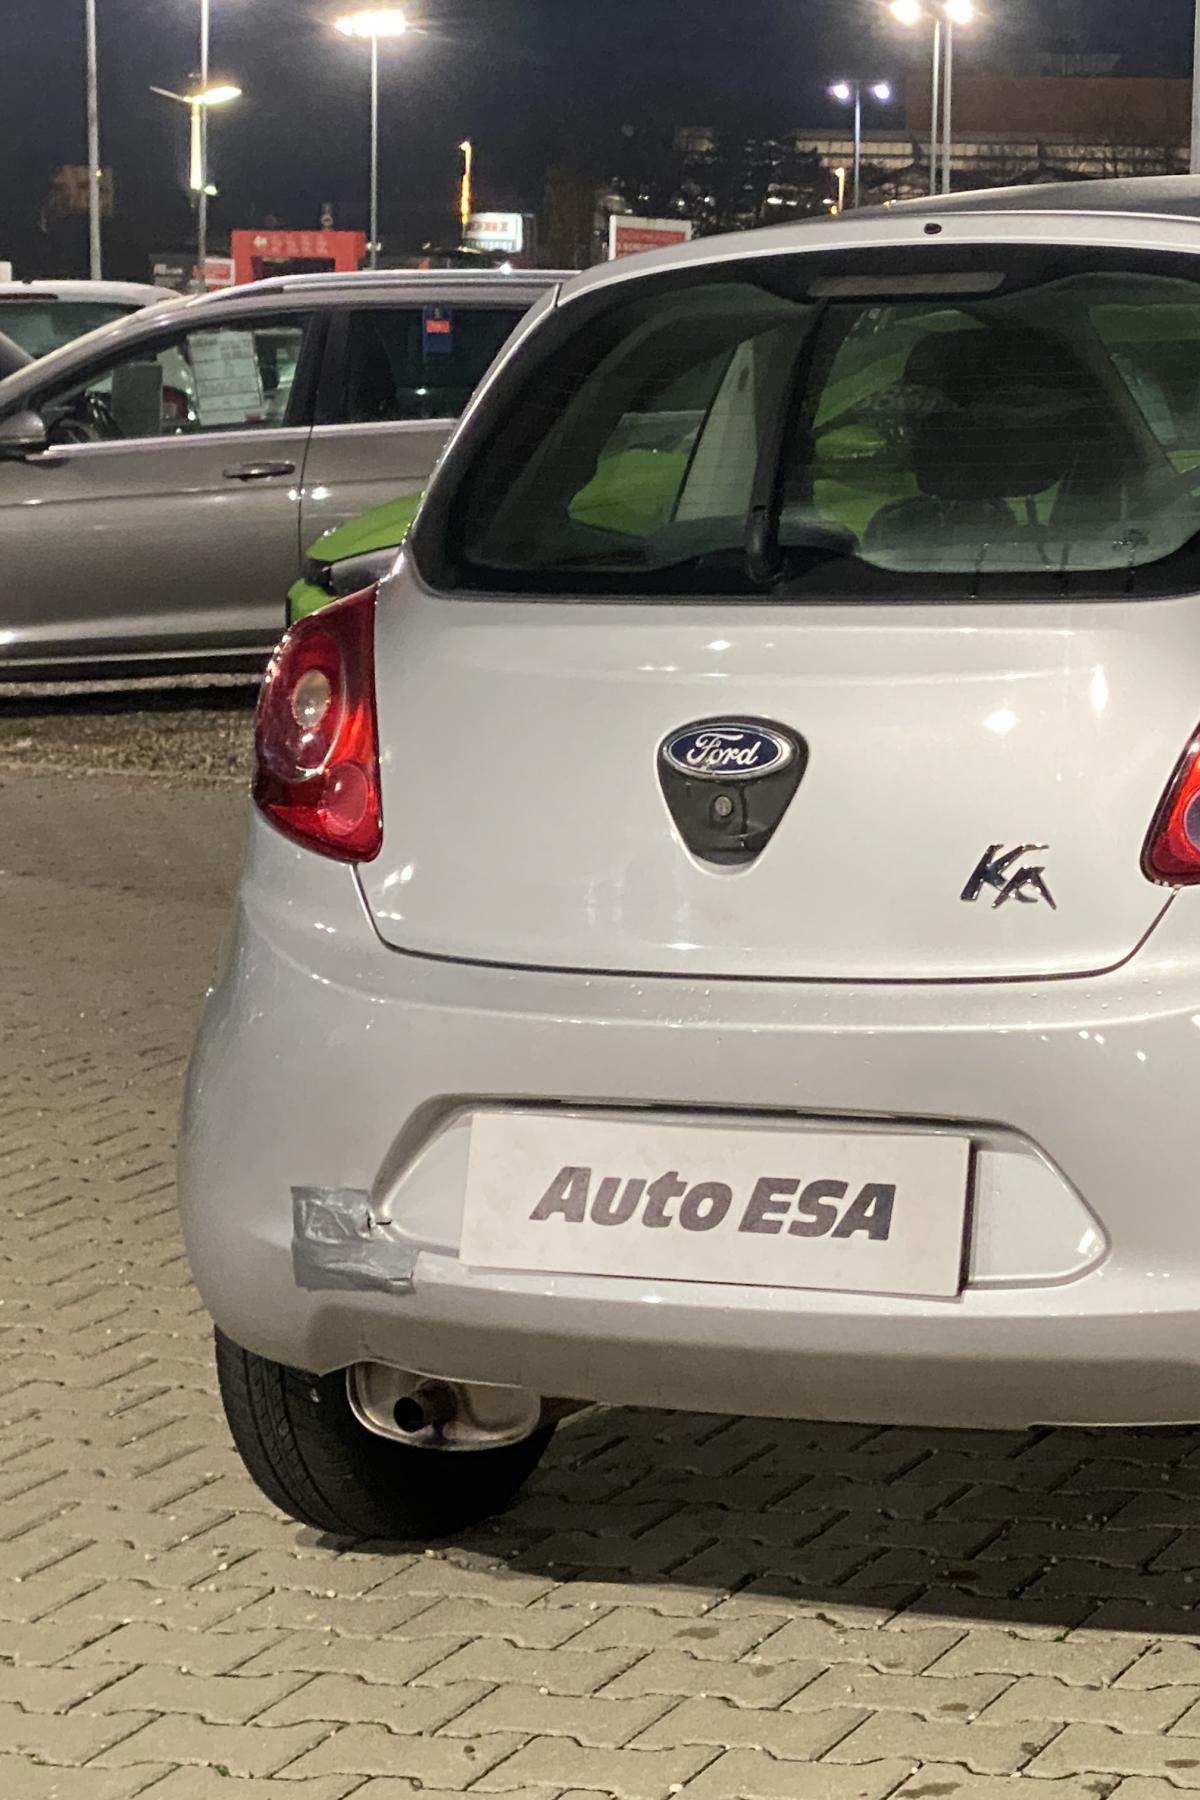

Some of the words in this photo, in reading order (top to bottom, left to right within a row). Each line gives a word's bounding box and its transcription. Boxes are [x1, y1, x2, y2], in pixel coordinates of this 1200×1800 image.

[686, 732, 763, 767] Ford
[528, 1165, 733, 1232] Auto
[738, 1177, 897, 1241] ESA
